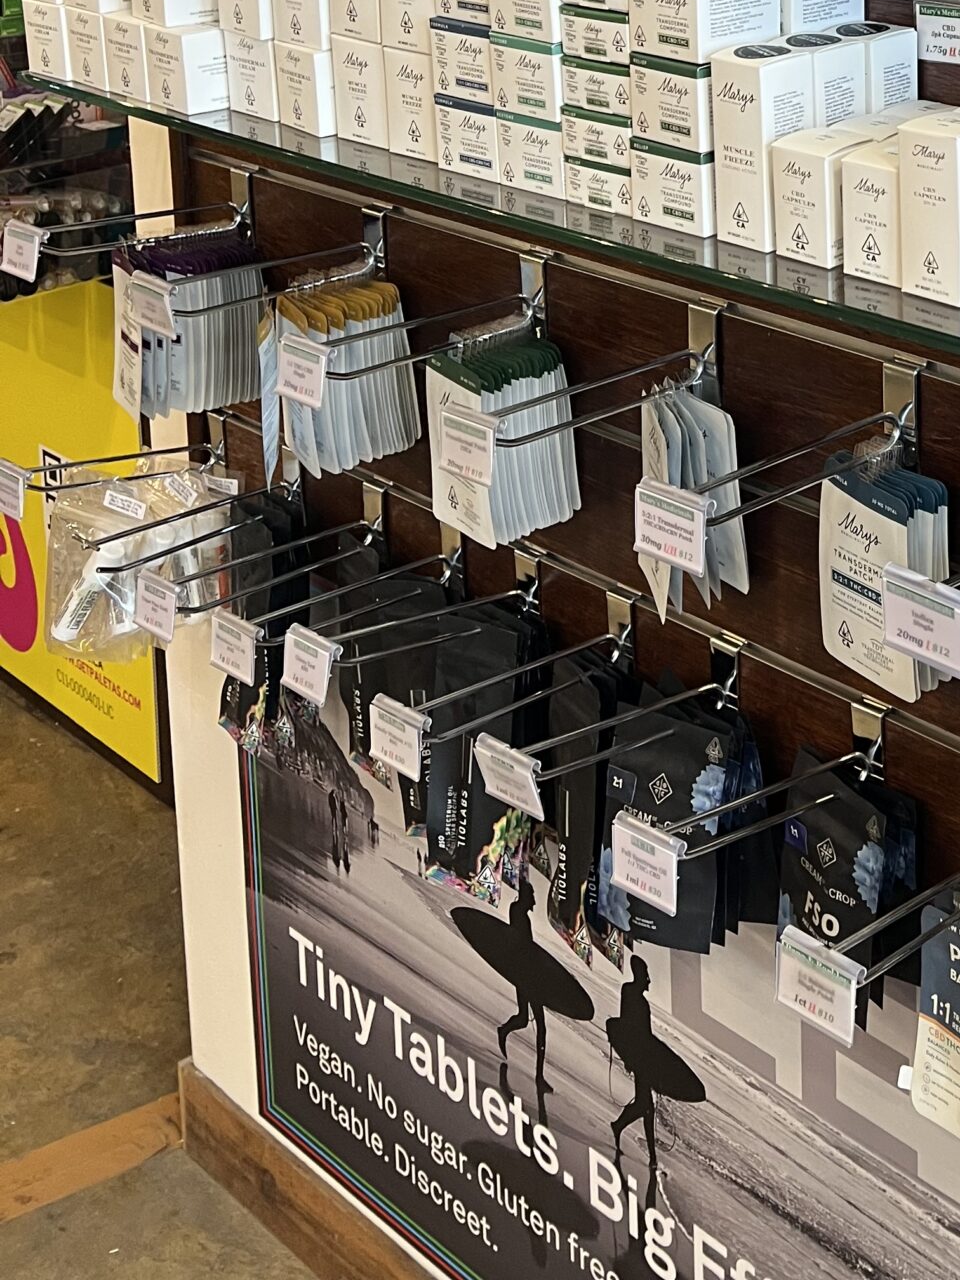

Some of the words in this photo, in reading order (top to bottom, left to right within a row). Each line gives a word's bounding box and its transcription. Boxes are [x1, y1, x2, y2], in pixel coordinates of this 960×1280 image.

[717, 82, 756, 112] Mary's
[723, 145, 755, 158] MUSCLE
[724, 154, 755, 168] FREEZE
[288, 925, 376, 1047] Tiny
[383, 996, 575, 1191] Tablets.
[588, 1146, 677, 1280] Big
[293, 1015, 363, 1094] Vegan.
[367, 1073, 397, 1119] No
[403, 1108, 473, 1180] sugar.
[477, 1157, 561, 1250] Gluten
[296, 1063, 389, 1163] Portable.
[394, 1146, 499, 1252] Discreet.
